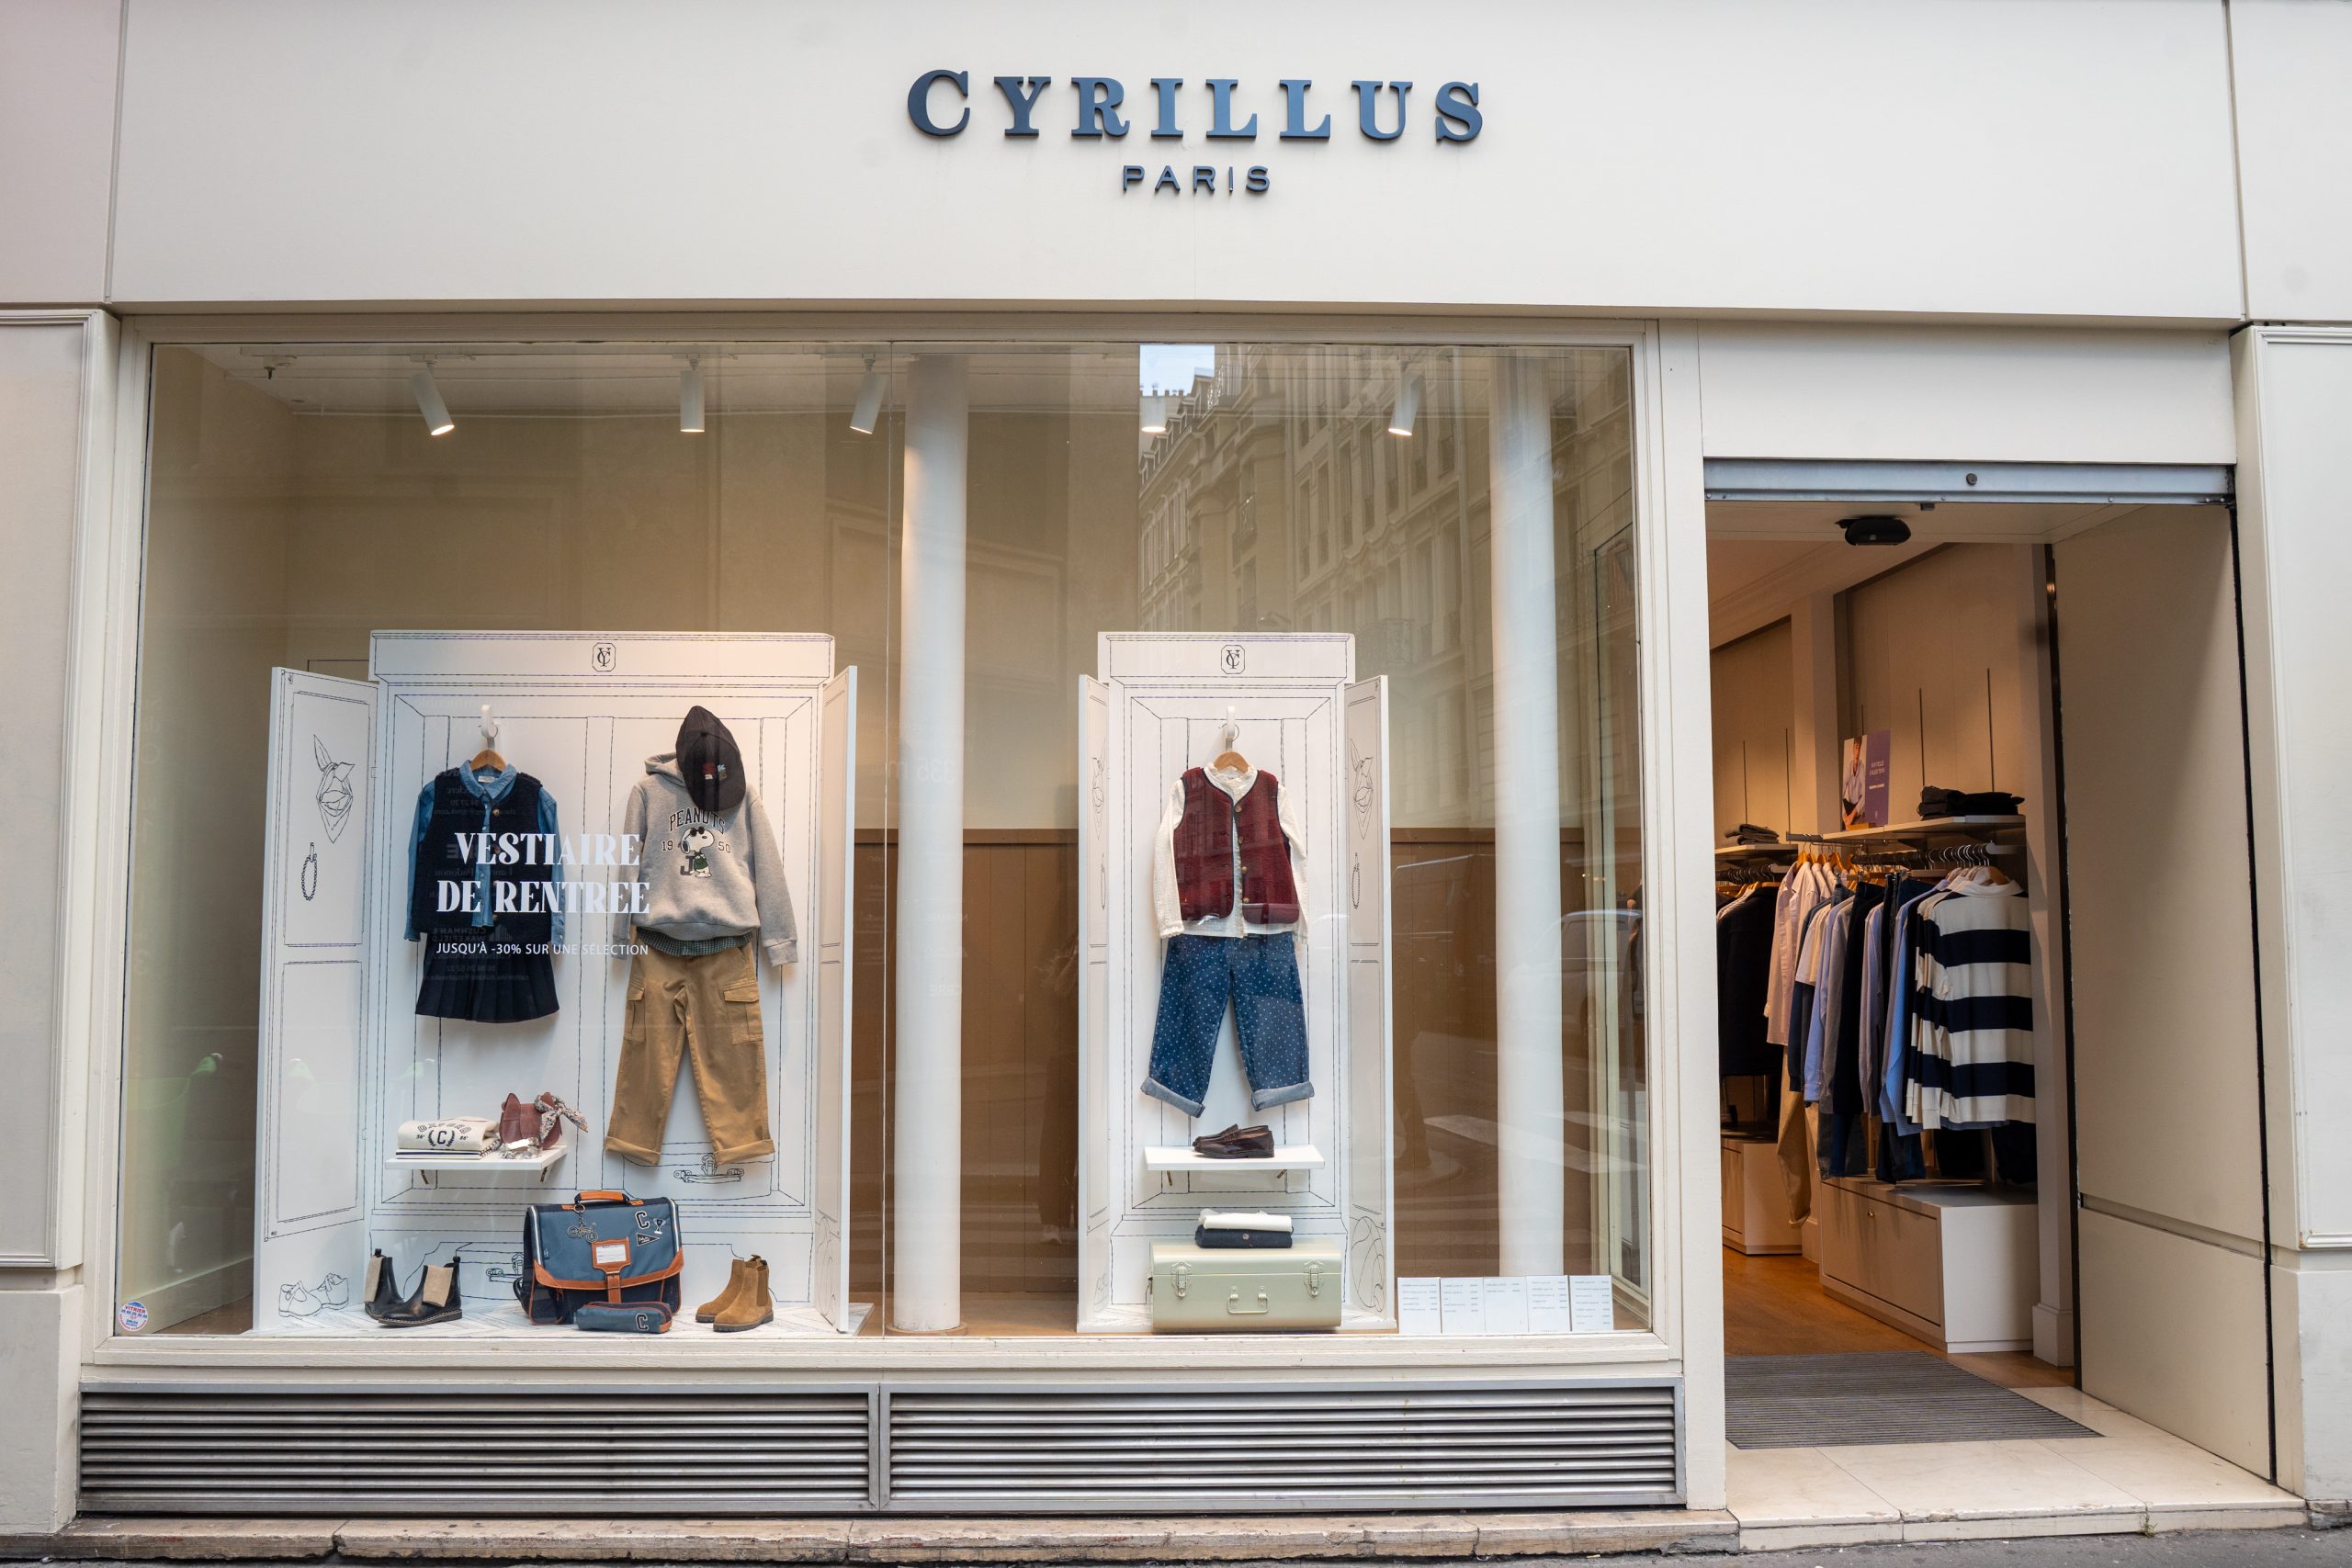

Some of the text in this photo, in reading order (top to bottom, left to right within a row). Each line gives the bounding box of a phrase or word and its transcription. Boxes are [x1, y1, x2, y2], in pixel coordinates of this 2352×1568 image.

[907, 69, 1483, 142] CYRILLUS
[1123, 164, 1271, 193] PARIS
[669, 807, 726, 835] PEANUTS
[454, 832, 640, 866] VESTIAIRE
[436, 880, 650, 914] DE RENTREE
[492, 943, 522, 954] -30%
[526, 943, 549, 954] SUR
[553, 944, 578, 954] UNE
[635, 1210, 650, 1230] C
[636, 1313, 649, 1331] C
